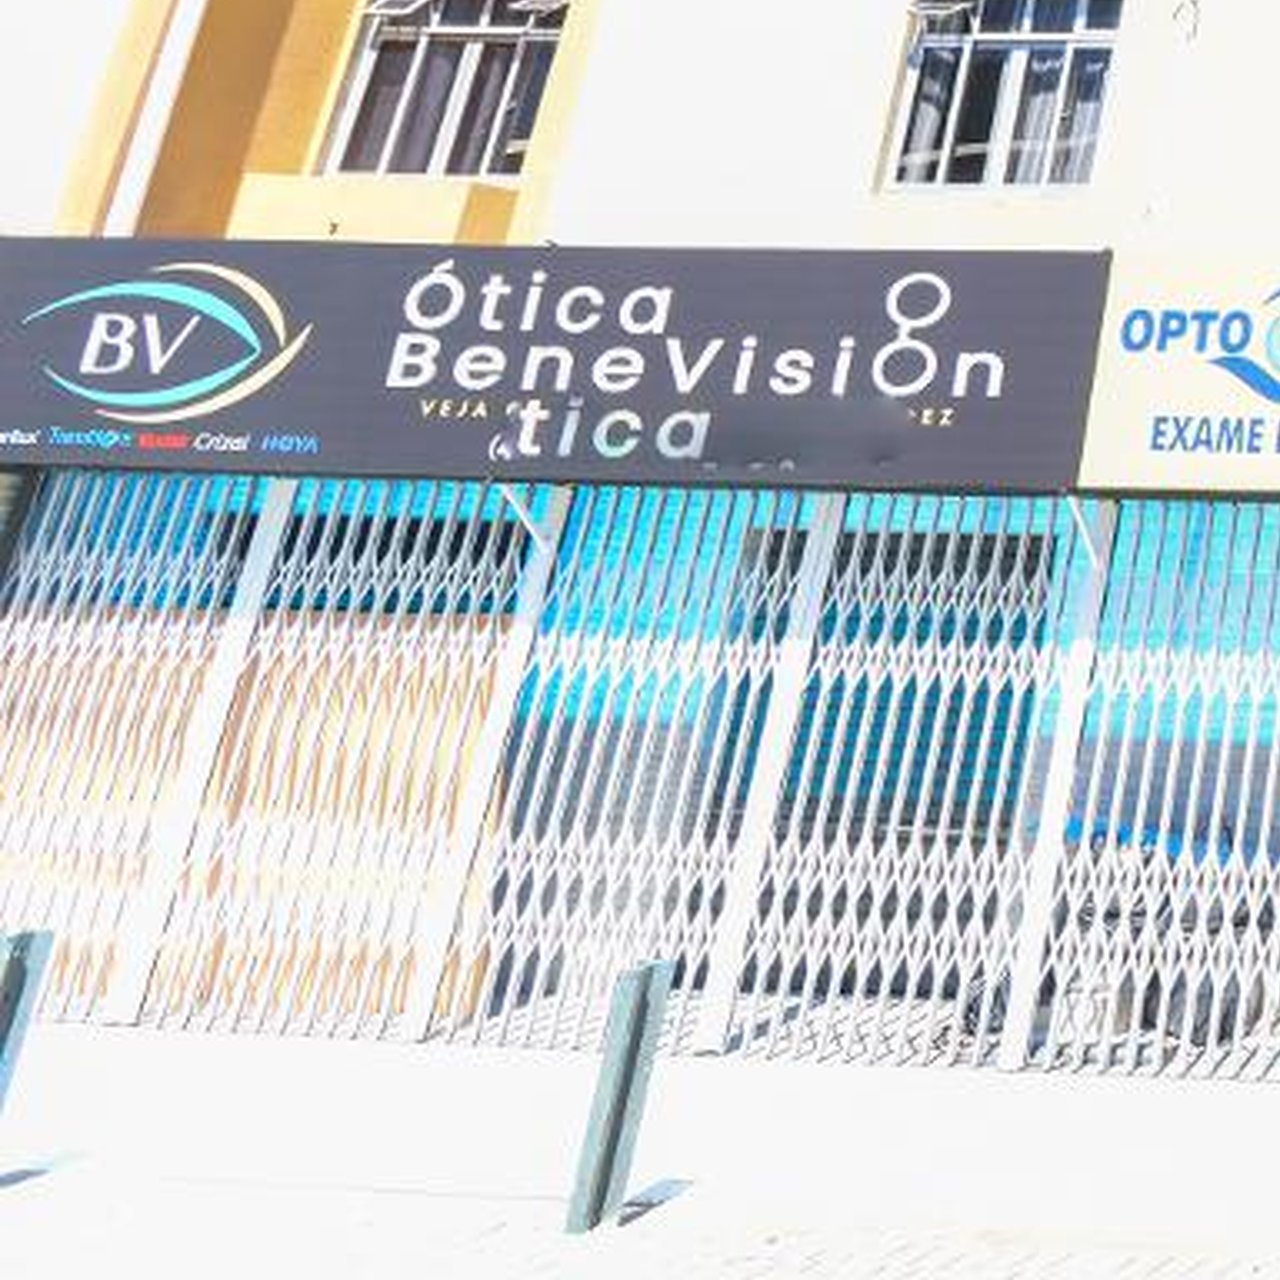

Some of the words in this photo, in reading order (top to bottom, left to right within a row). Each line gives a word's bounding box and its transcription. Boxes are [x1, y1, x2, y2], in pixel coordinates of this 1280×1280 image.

[403, 258, 673, 335] Ótica
[79, 312, 200, 376] BV
[1120, 308, 1253, 353] OPTO
[420, 399, 488, 418] VEJA
[1149, 415, 1264, 454] EXAME
